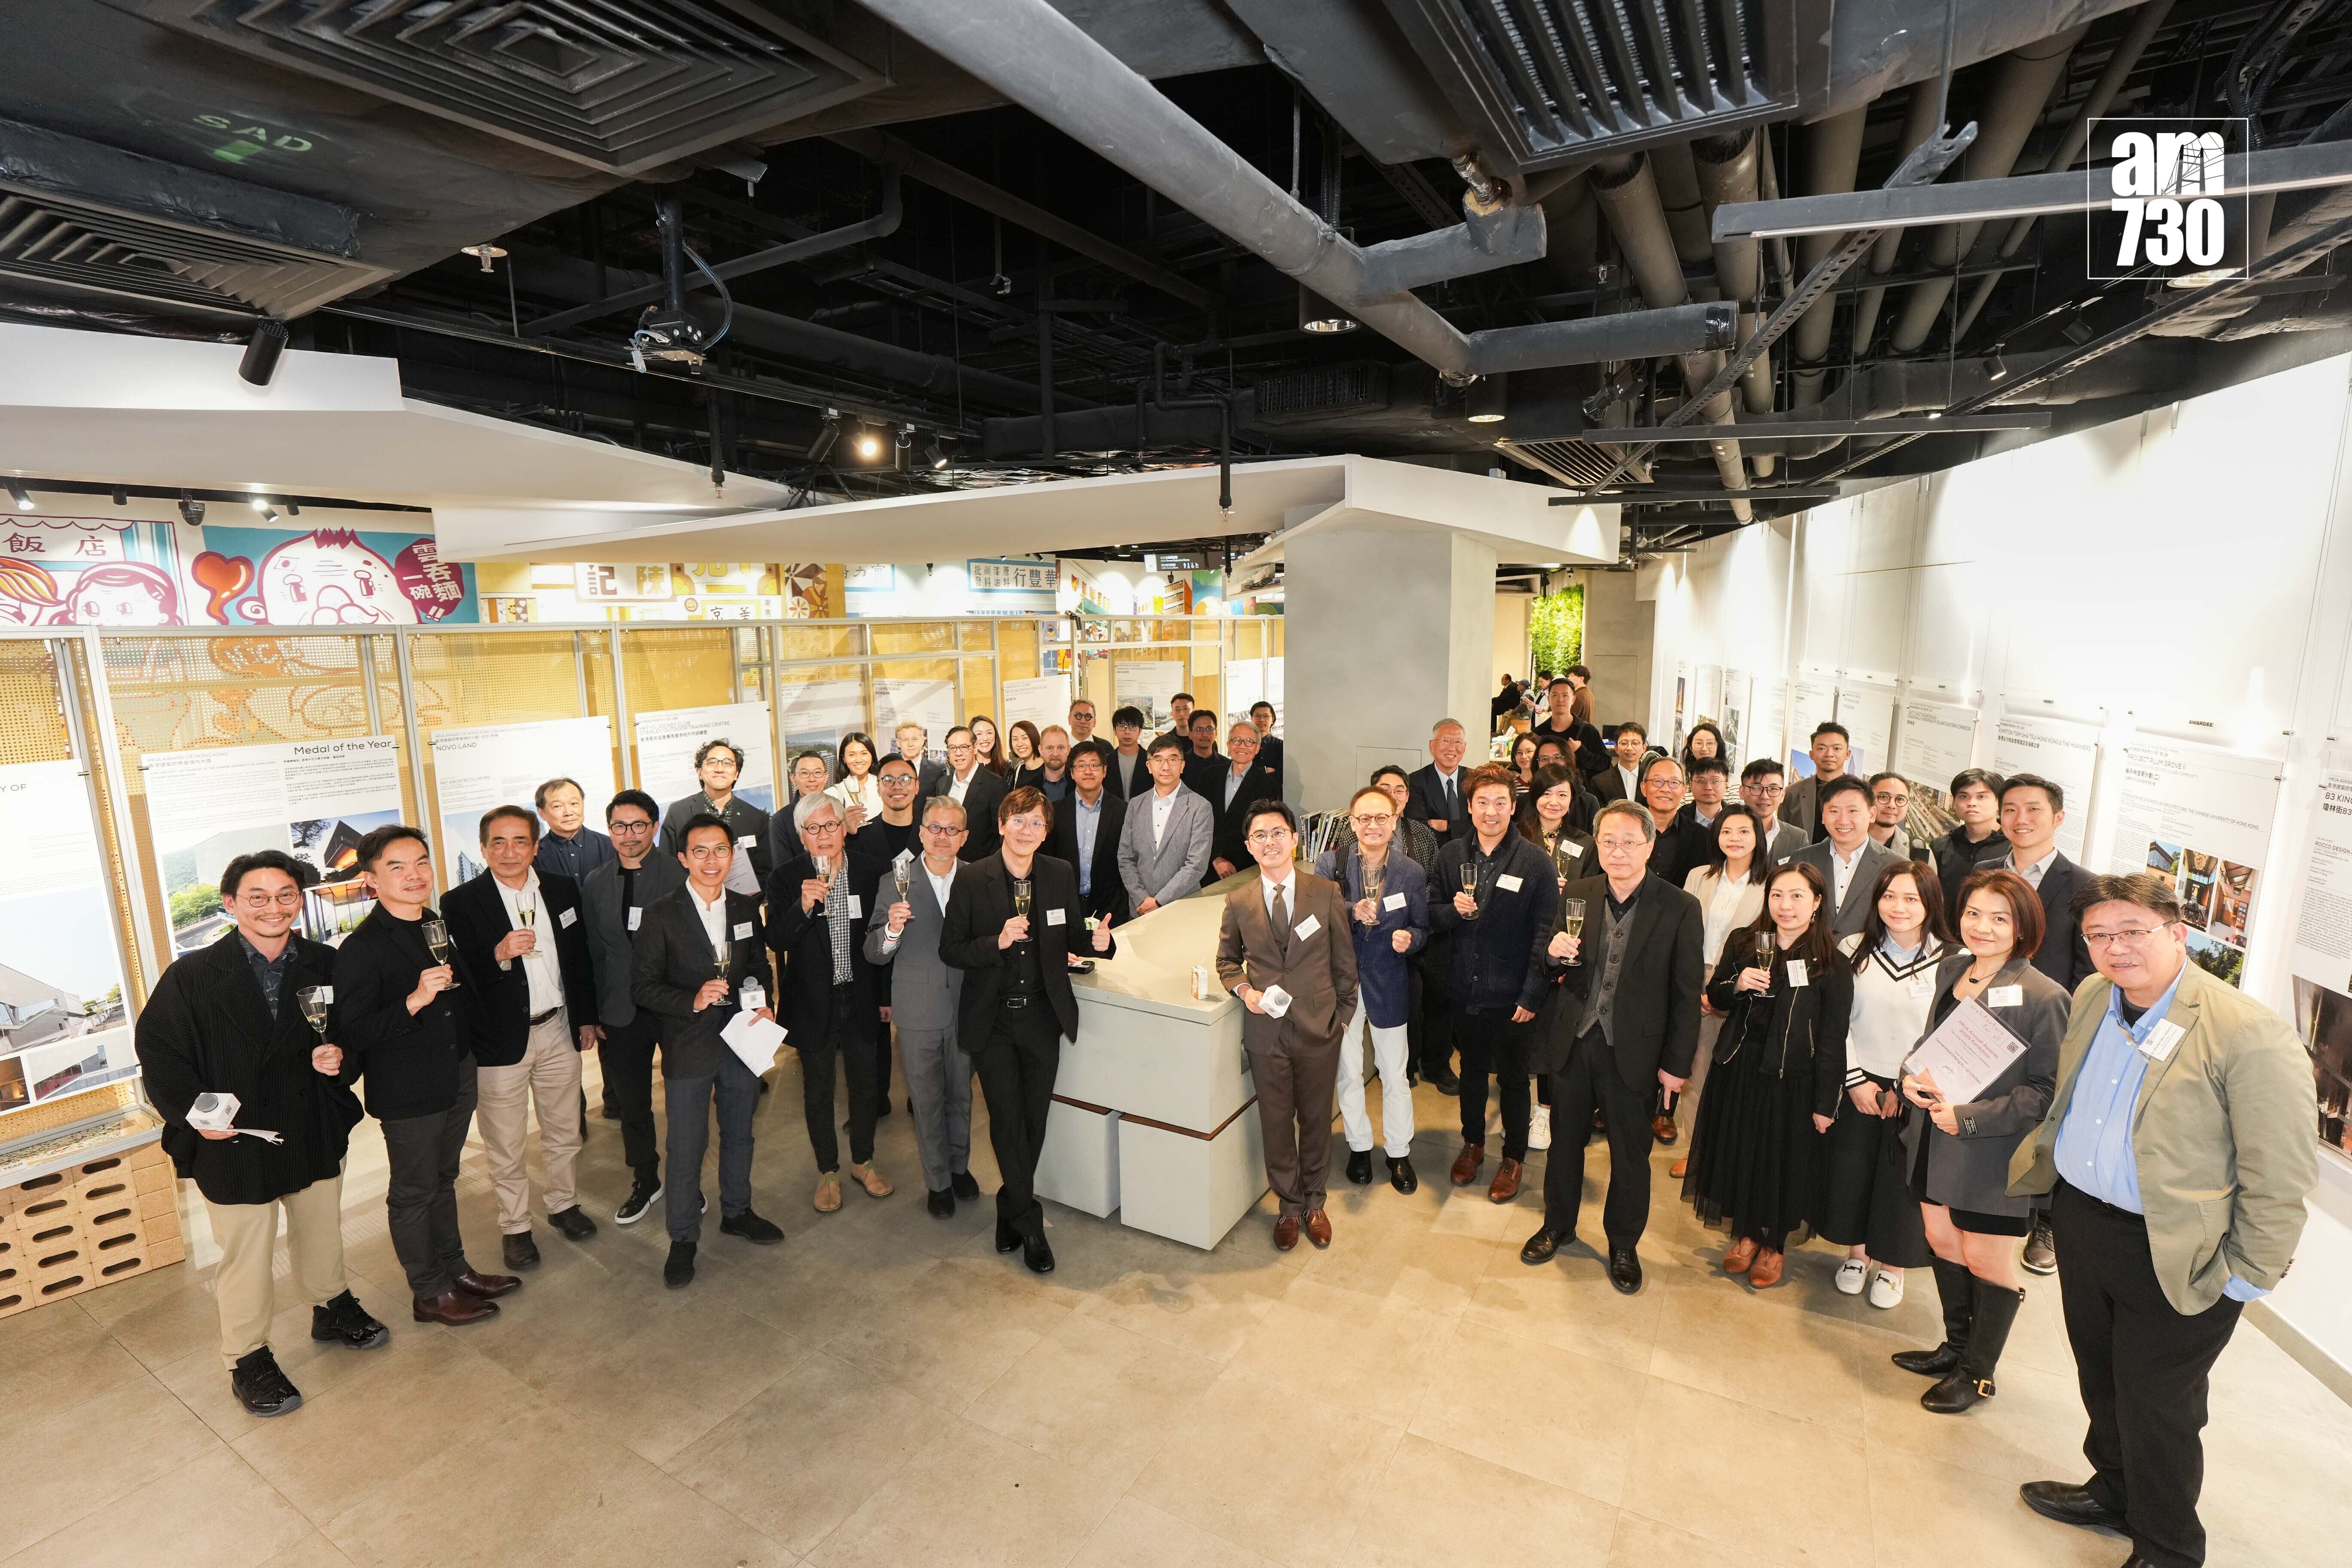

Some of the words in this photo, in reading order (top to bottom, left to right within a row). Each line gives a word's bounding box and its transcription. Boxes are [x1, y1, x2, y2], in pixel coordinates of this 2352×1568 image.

[193, 115, 312, 151] SAD
[294, 745, 330, 755] Medal
[333, 743, 344, 752] of
[347, 743, 365, 751] the
[2127, 753, 2148, 762] PROJECT
[2164, 760, 2181, 769] GROVE
[2325, 792, 2335, 800] 83
[2209, 814, 2230, 824] UNIVERSITY
[2315, 841, 2331, 849] ROCCO
[2332, 845, 2351, 854] DESIGN
[1958, 1020, 1969, 1031] HKIA
[1968, 1029, 1984, 1044] Annual
[1982, 1043, 1999, 1059] Awards
[1959, 1029, 1971, 1041] 2025
[1970, 1039, 1992, 1060] Exhibition
[1934, 1037, 1953, 1055] Cementaid
[1950, 1053, 1962, 1065] (Hong
[1959, 1062, 1971, 1074] Kong)
[1968, 1072, 1982, 1084] Limited
